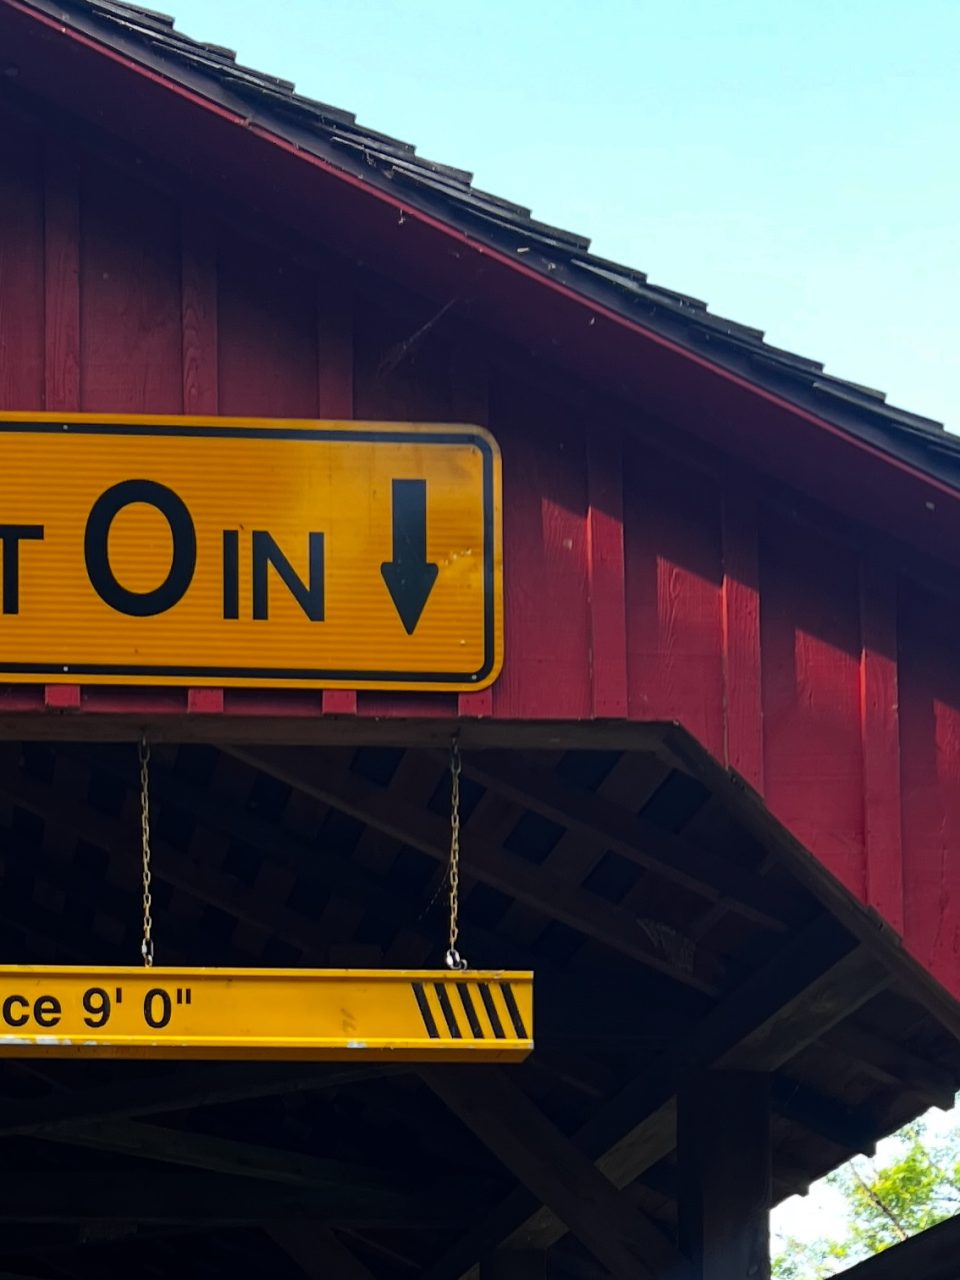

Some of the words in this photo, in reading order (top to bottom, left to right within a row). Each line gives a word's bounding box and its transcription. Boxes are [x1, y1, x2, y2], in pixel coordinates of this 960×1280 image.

[83, 478, 198, 618] 0
[223, 530, 325, 622] IN
[82, 987, 123, 1029] 9'
[143, 987, 192, 1029] 0"
